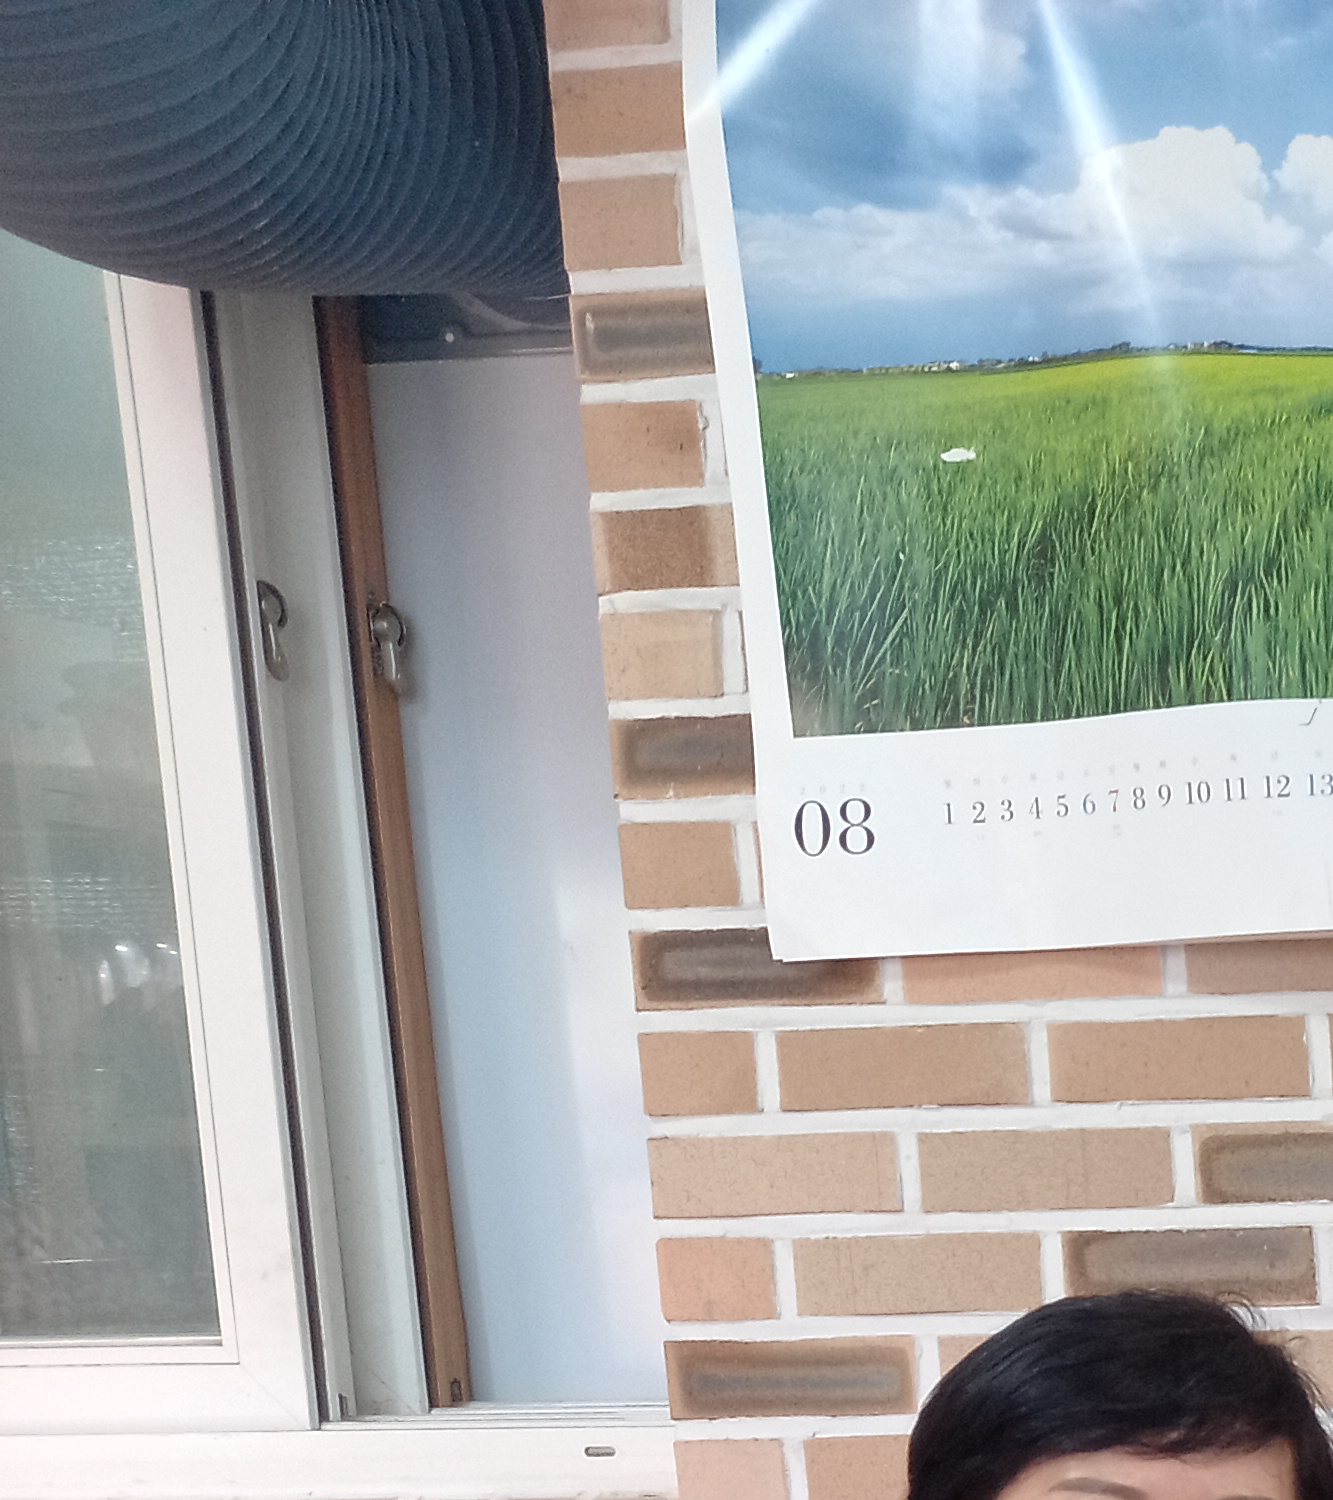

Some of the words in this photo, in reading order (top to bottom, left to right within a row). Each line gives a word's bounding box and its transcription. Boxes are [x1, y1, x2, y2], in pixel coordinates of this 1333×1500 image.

[793, 797, 876, 858] 08
[944, 802, 954, 825] 1
[971, 801, 987, 824] 2
[1000, 798, 1014, 822] 3
[1029, 796, 1043, 820] 4
[1056, 793, 1069, 818] 5
[1082, 792, 1097, 815] 6
[1108, 788, 1120, 813] 7
[1132, 786, 1146, 811] 8
[1157, 784, 1172, 808] 9
[1186, 780, 1211, 805] 10
[1225, 776, 1247, 802] 11
[1264, 774, 1291, 799] 12
